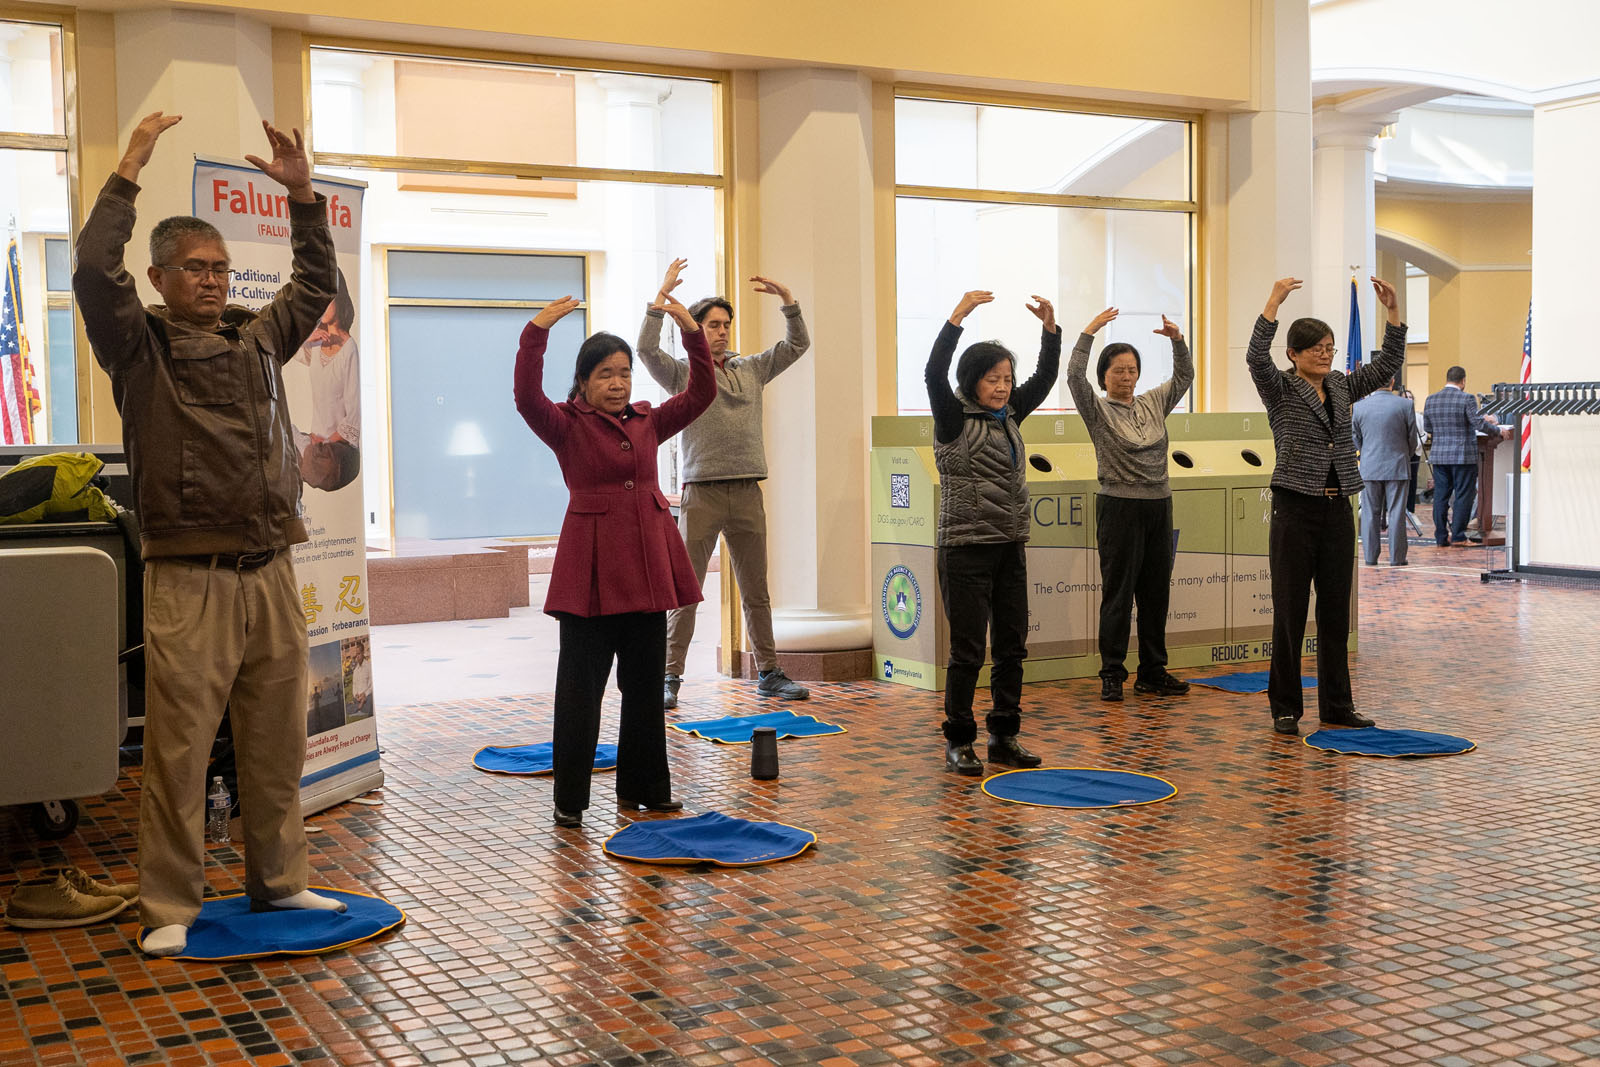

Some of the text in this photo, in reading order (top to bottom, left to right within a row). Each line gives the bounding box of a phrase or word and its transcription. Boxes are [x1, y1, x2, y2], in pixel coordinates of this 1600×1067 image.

[213, 179, 352, 228] Falun fa
[234, 269, 281, 283] aditional
[1030, 496, 1083, 527] CLE
[328, 548, 354, 560] countries
[1177, 576, 1204, 588] many
[1206, 571, 1230, 584] other
[1233, 571, 1257, 583] items
[335, 575, 365, 615] 忍
[1034, 583, 1053, 595] The
[1174, 610, 1197, 622] lamps
[1212, 644, 1249, 662] REDUCE
[893, 667, 922, 679] pennsylvania
